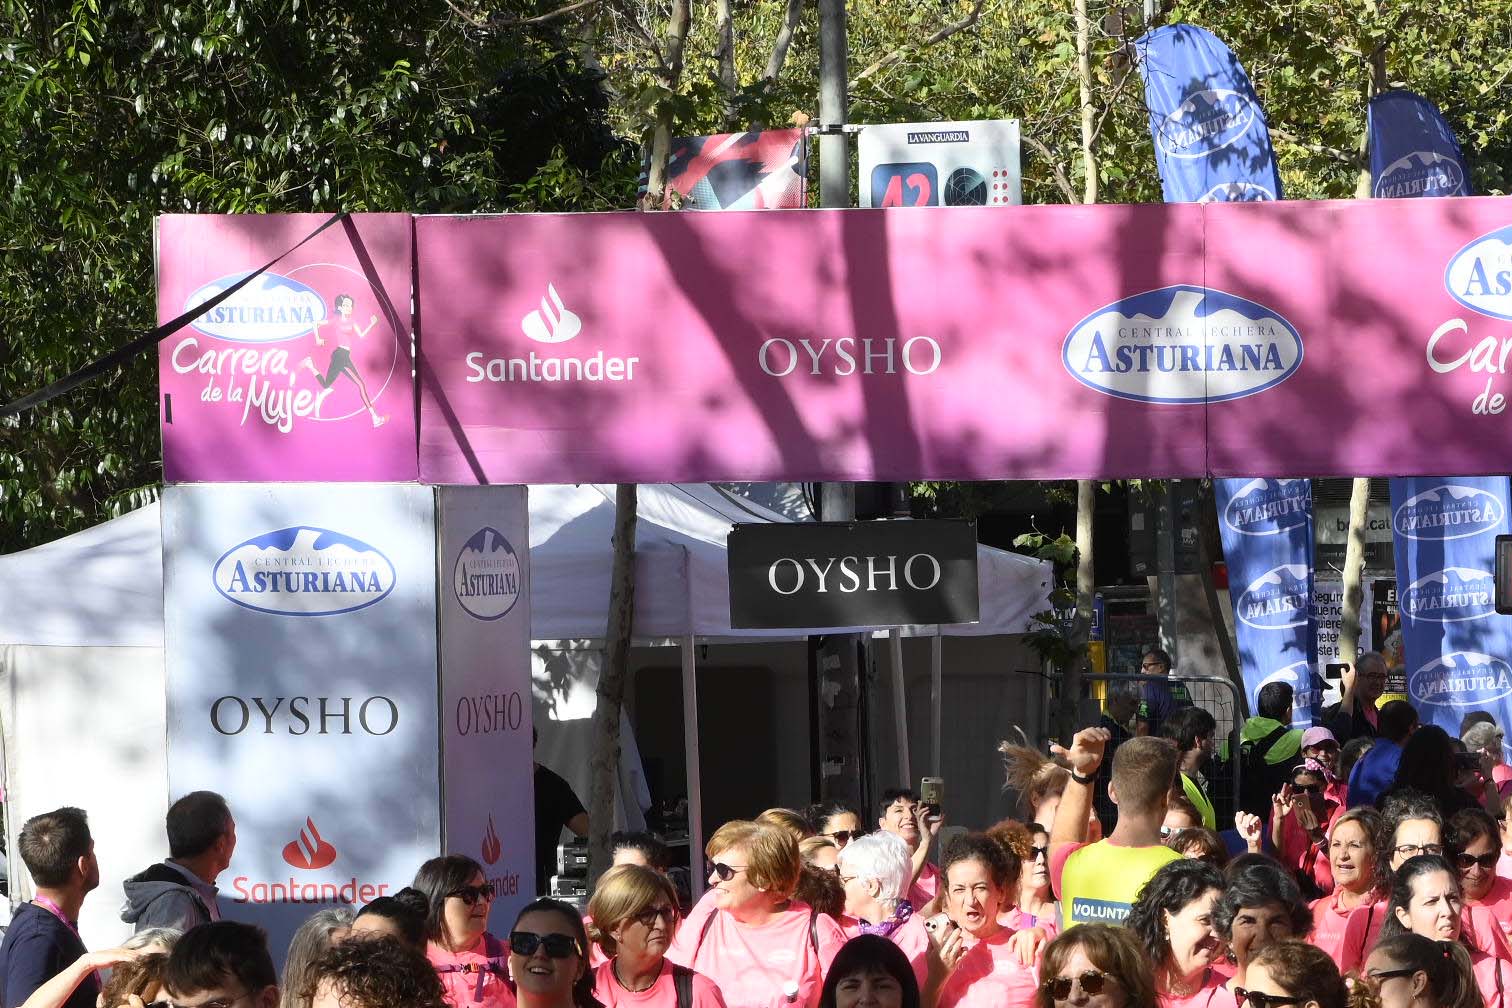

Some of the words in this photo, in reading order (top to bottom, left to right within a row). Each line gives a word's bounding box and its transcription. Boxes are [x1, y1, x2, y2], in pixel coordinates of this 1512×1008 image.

[1118, 327, 1192, 338] CENTRAL
[1200, 325, 1276, 337] LECHERA
[171, 337, 289, 375] Carrera
[465, 350, 640, 383] Santander
[758, 336, 943, 377] OYSHO
[1081, 330, 1285, 374] ASTURIANA
[200, 378, 222, 402] de
[227, 375, 244, 402] la
[240, 372, 334, 434] Mujer
[1471, 377, 1506, 416] de
[227, 560, 383, 593] ASTURIANA
[254, 557, 312, 567] CENTRAL
[459, 563, 517, 597] ASTURIANA
[767, 553, 942, 595] OYSHO
[209, 695, 399, 736] OYSHO
[456, 691, 522, 736] OYSHO
[232, 876, 391, 905] Santander
